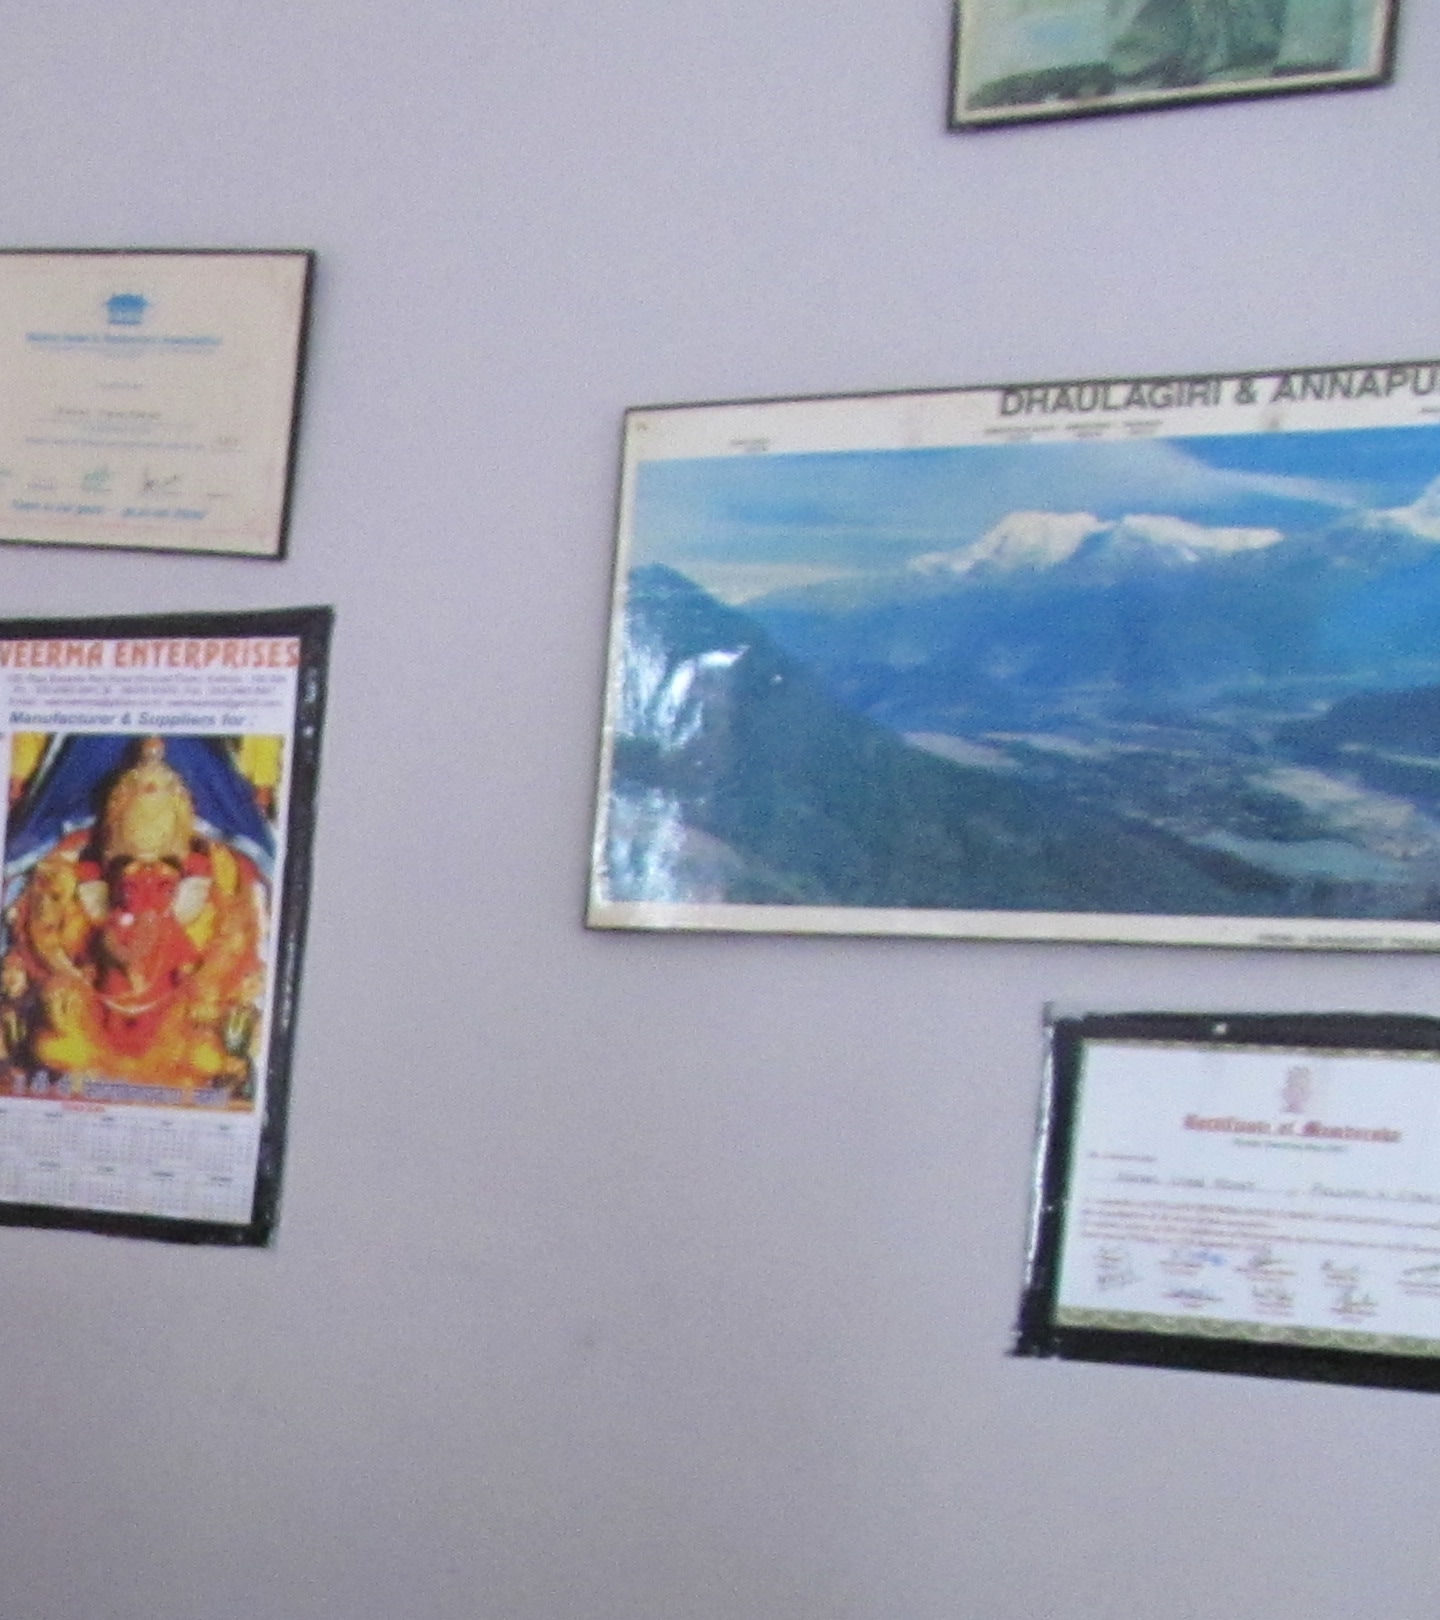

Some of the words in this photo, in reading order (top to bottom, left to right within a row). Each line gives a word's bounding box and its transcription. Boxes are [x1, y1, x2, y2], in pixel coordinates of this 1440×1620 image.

[999, 378, 1219, 416] DHAULAGIRI
[1235, 377, 1257, 405] &
[115, 639, 300, 669] ENTERPRISES
